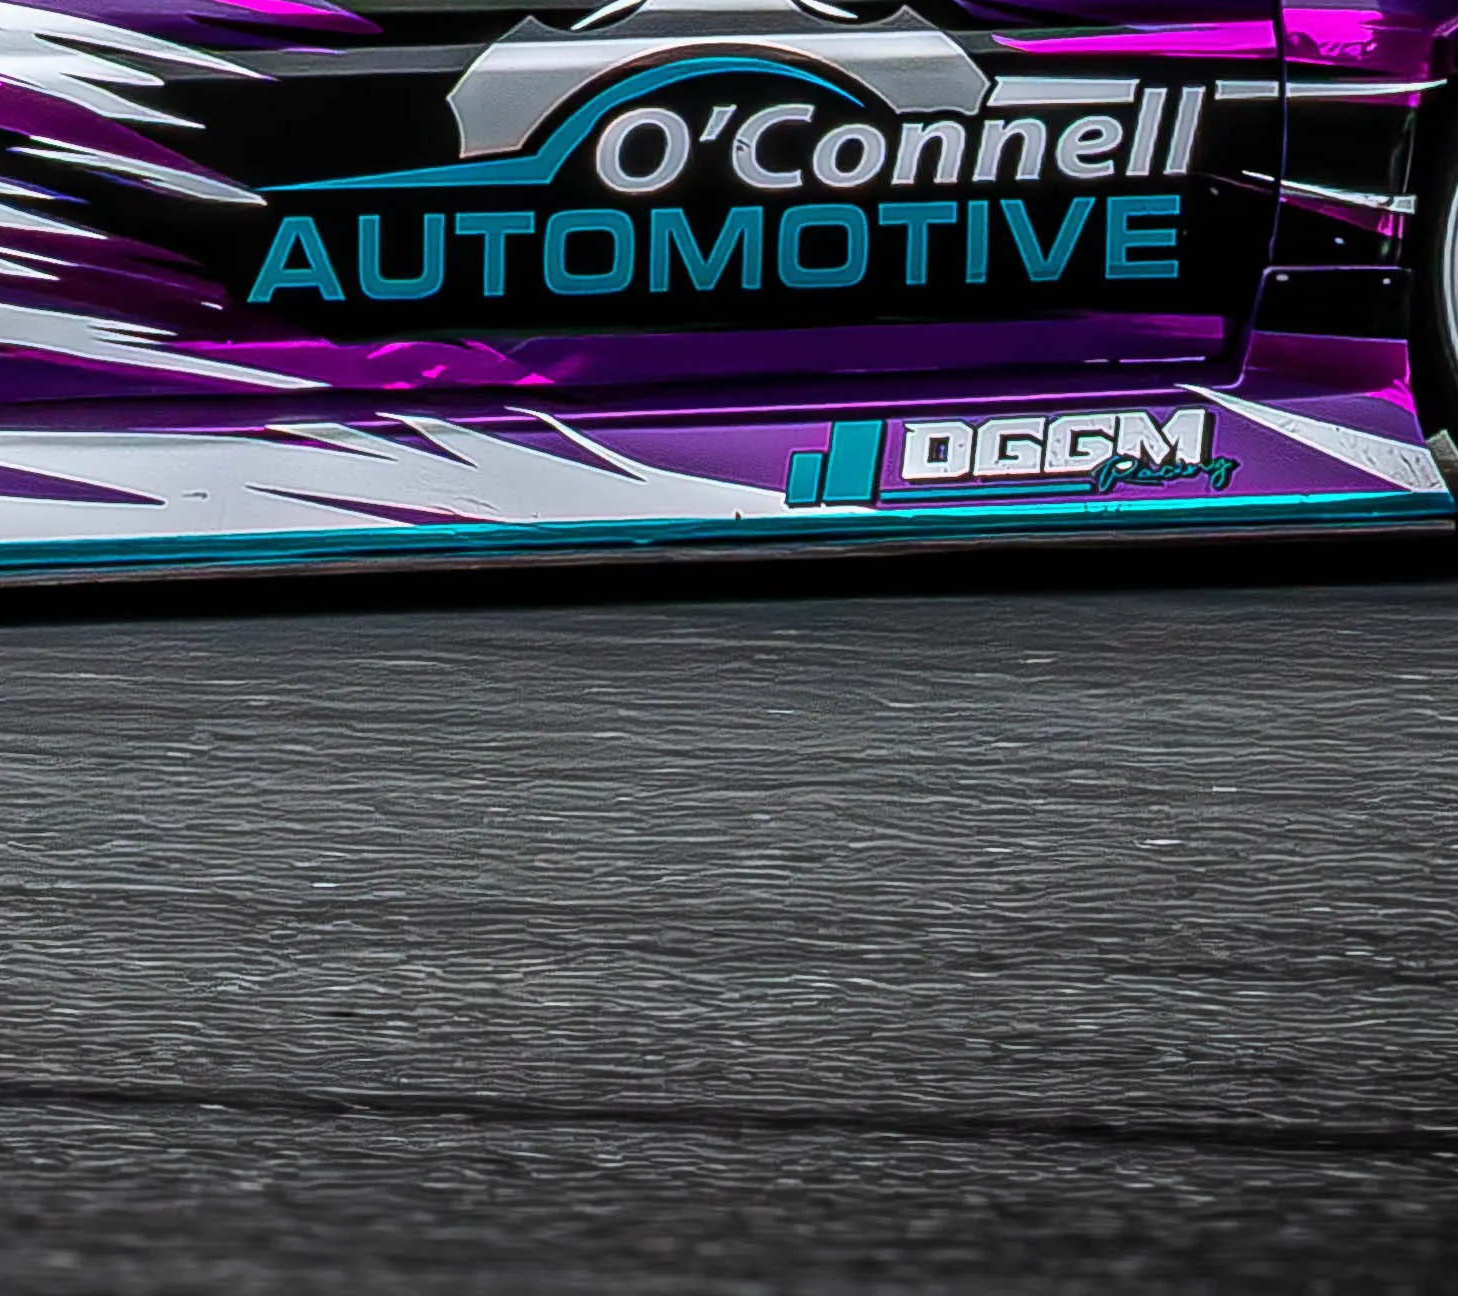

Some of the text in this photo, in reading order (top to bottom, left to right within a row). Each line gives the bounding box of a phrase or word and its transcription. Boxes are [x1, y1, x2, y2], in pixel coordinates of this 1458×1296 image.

[595, 85, 1206, 193] O'Connell
[247, 194, 1181, 303] AUTOMOTIVE
[902, 409, 1208, 479] DGGM
